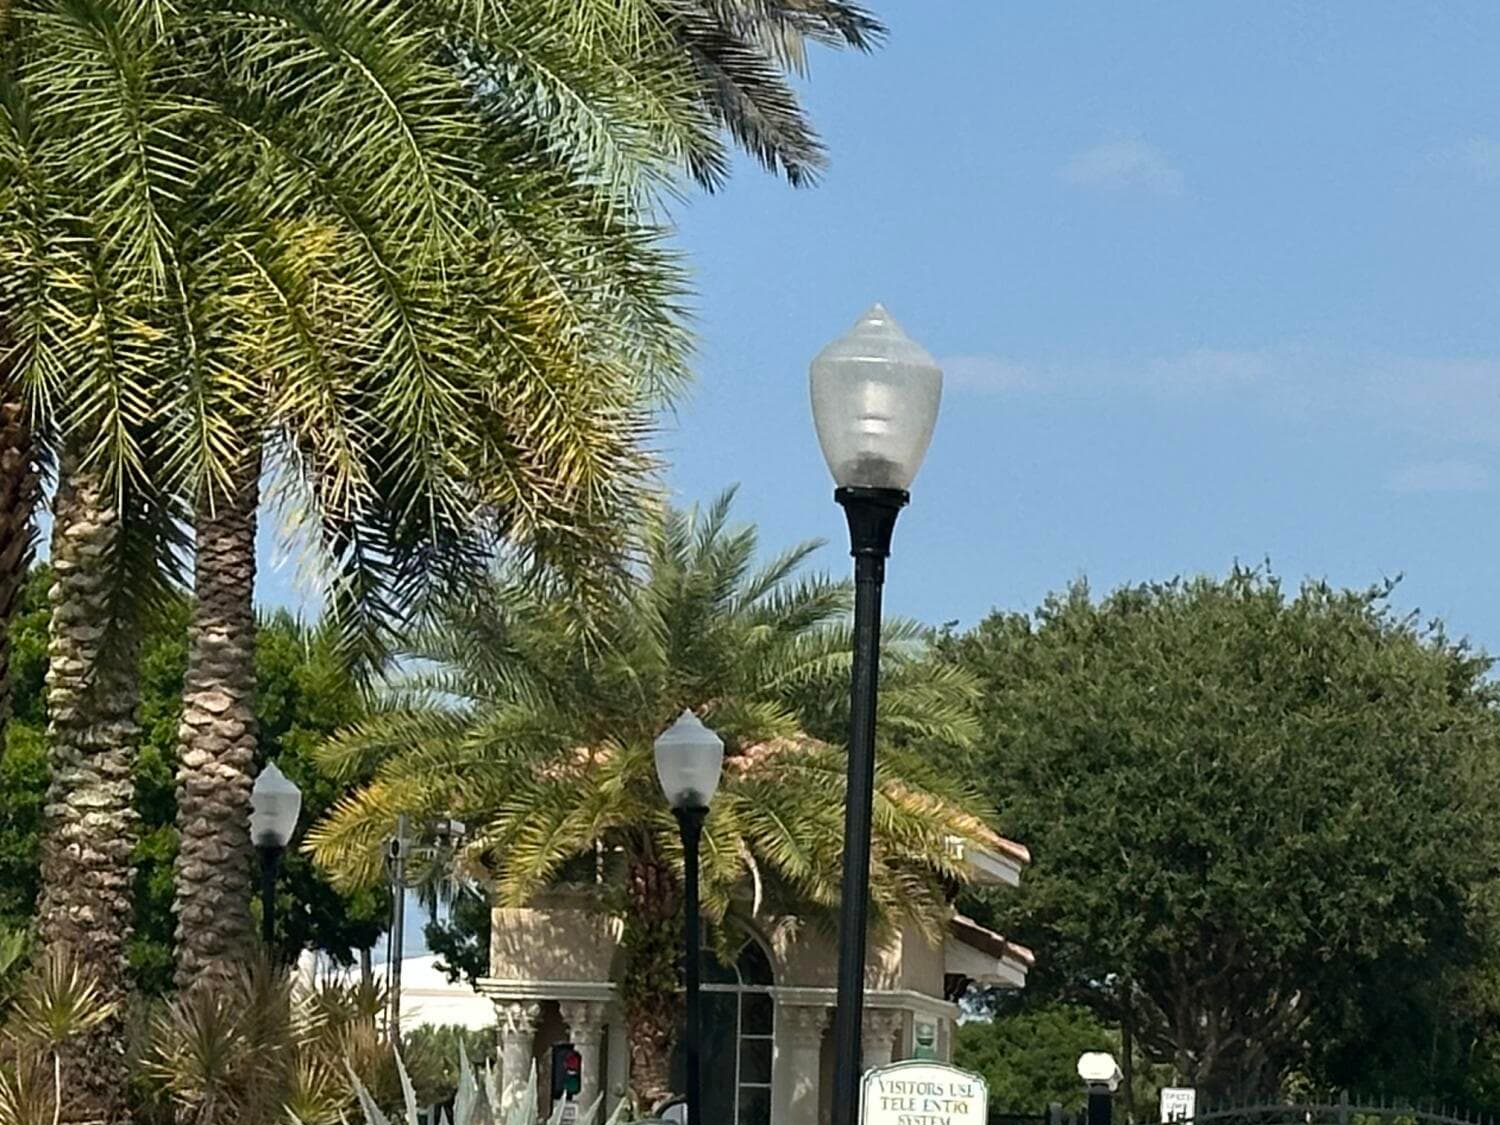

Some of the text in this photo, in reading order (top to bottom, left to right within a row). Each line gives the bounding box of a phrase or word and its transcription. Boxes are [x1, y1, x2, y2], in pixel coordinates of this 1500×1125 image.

[879, 1080, 975, 1098] VISITORS USE
[880, 1096, 969, 1114] TELE ENTRY
